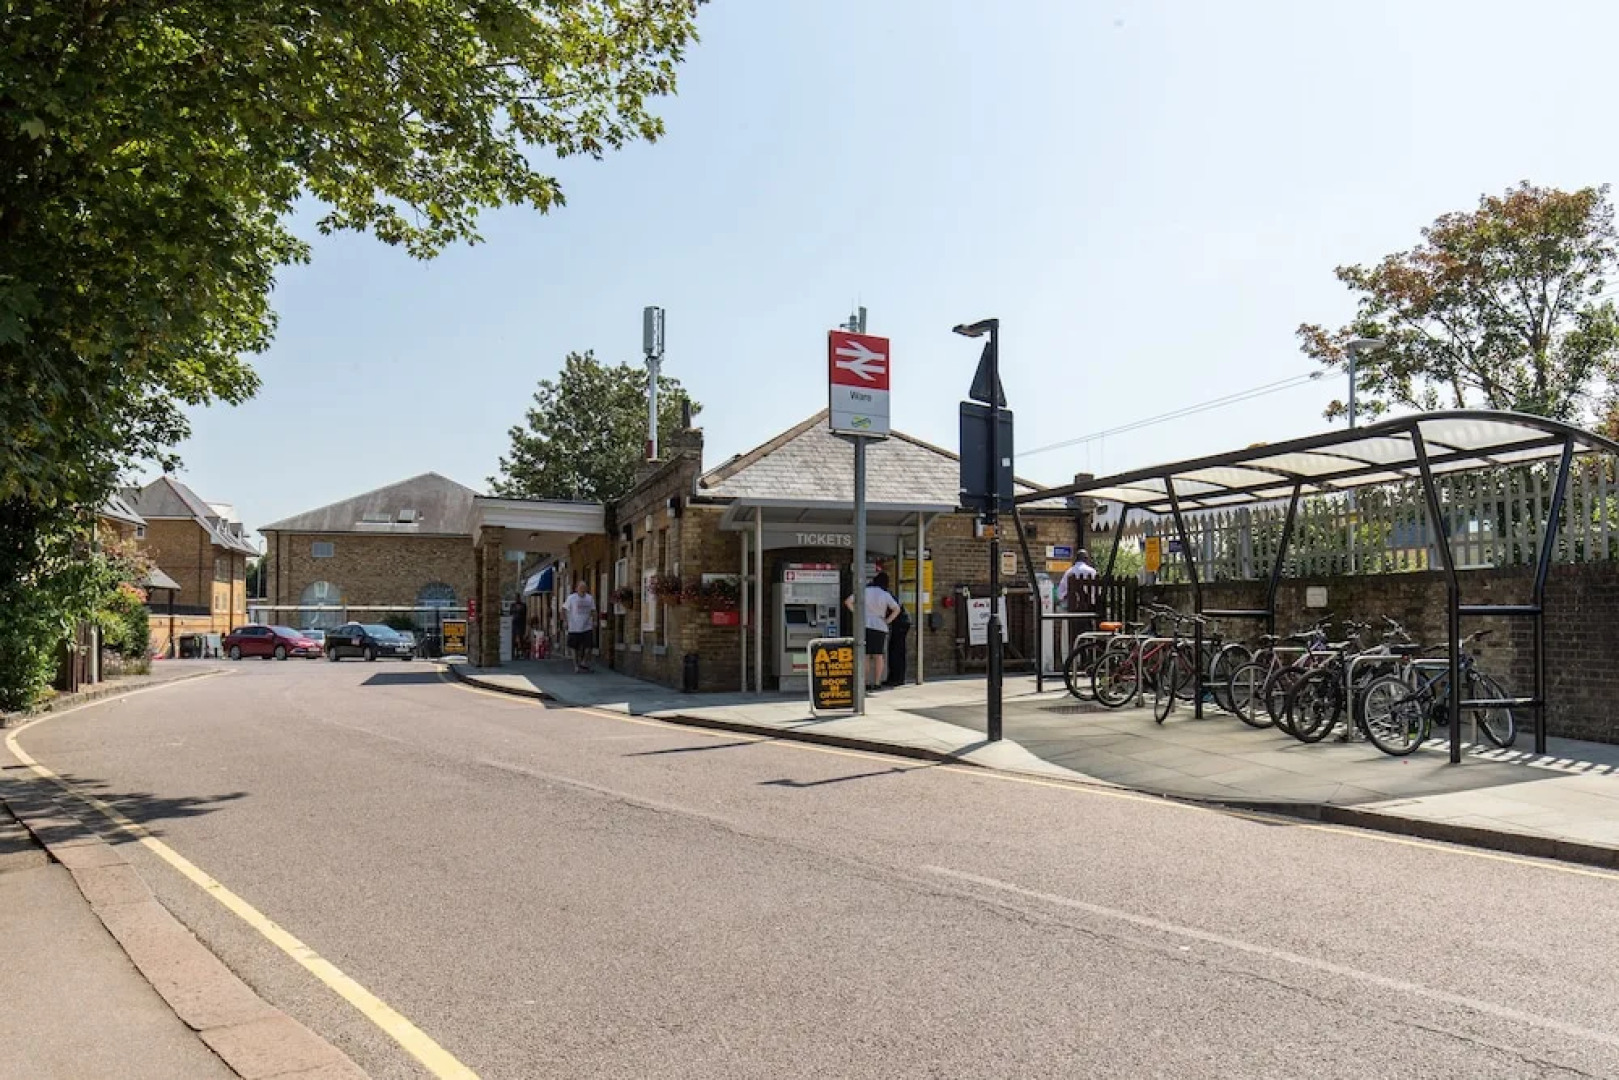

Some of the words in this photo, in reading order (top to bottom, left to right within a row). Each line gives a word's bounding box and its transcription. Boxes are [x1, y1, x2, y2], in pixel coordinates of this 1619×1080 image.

[850, 391, 872, 402] Ware
[796, 533, 851, 546] TICKETS
[815, 648, 853, 662] A2B
